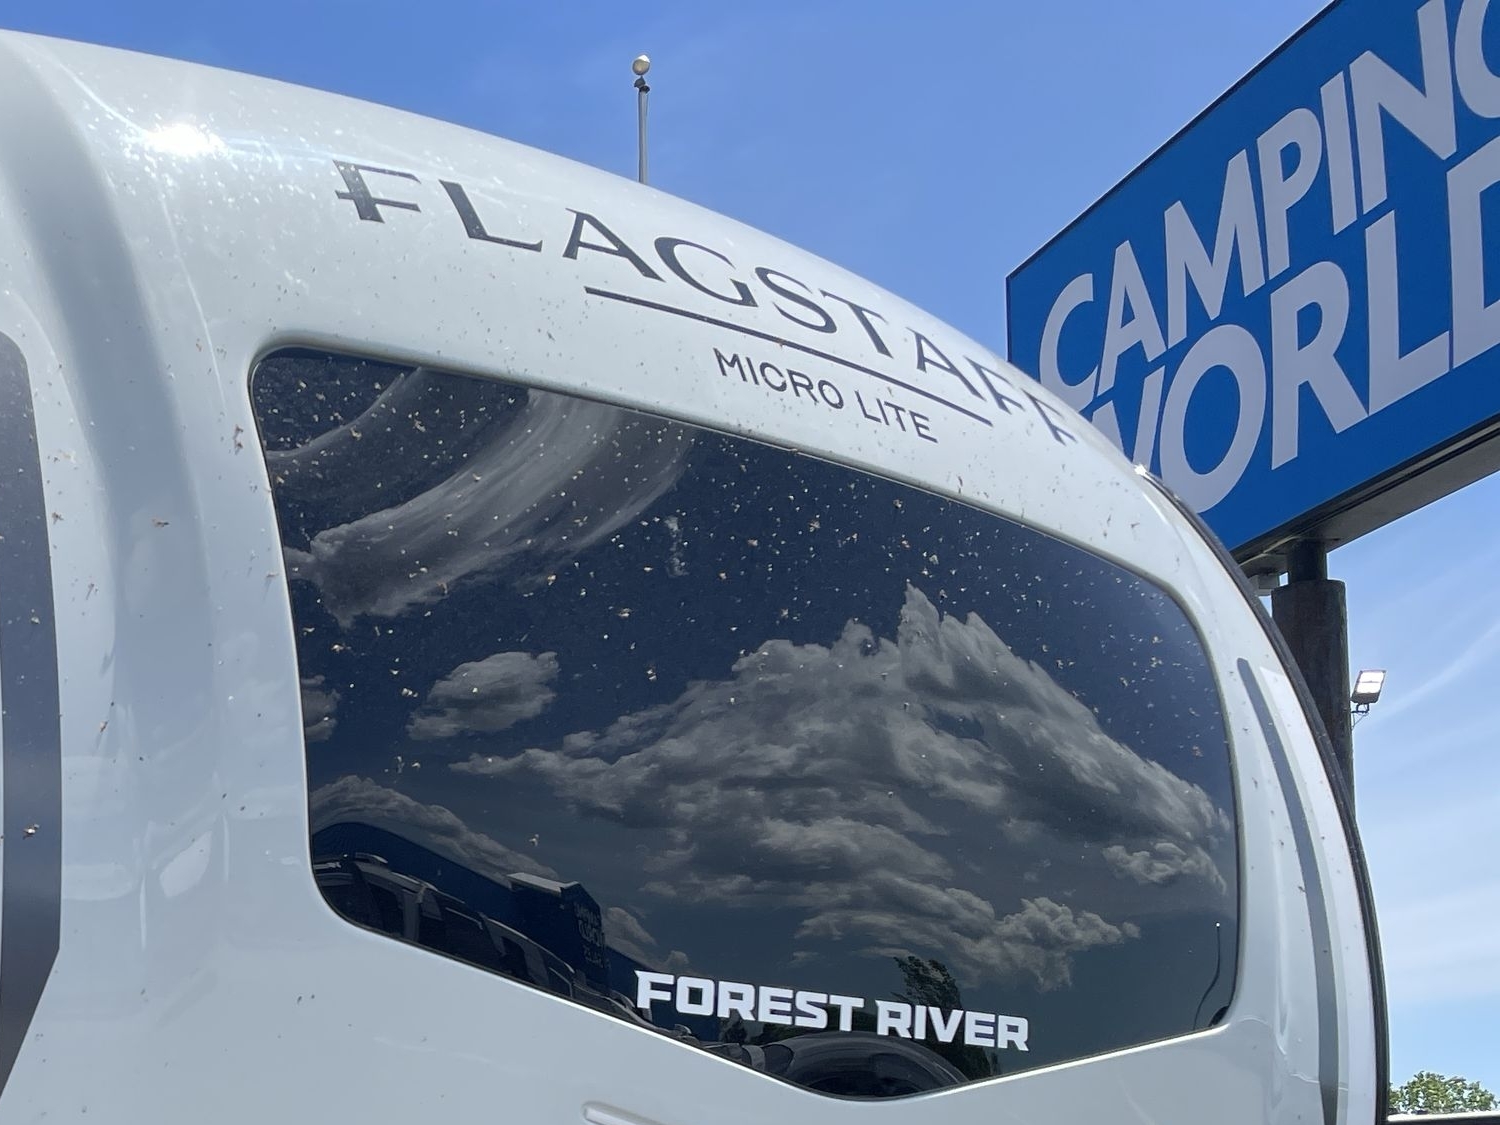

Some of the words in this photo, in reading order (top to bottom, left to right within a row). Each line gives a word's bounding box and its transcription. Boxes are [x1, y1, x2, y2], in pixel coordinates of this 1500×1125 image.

[332, 159, 1078, 446] FLAGSTAFF
[712, 347, 845, 411] MICRO
[854, 390, 940, 444] LITE
[633, 969, 865, 1032] FOREST
[874, 998, 1030, 1052] RIVER
